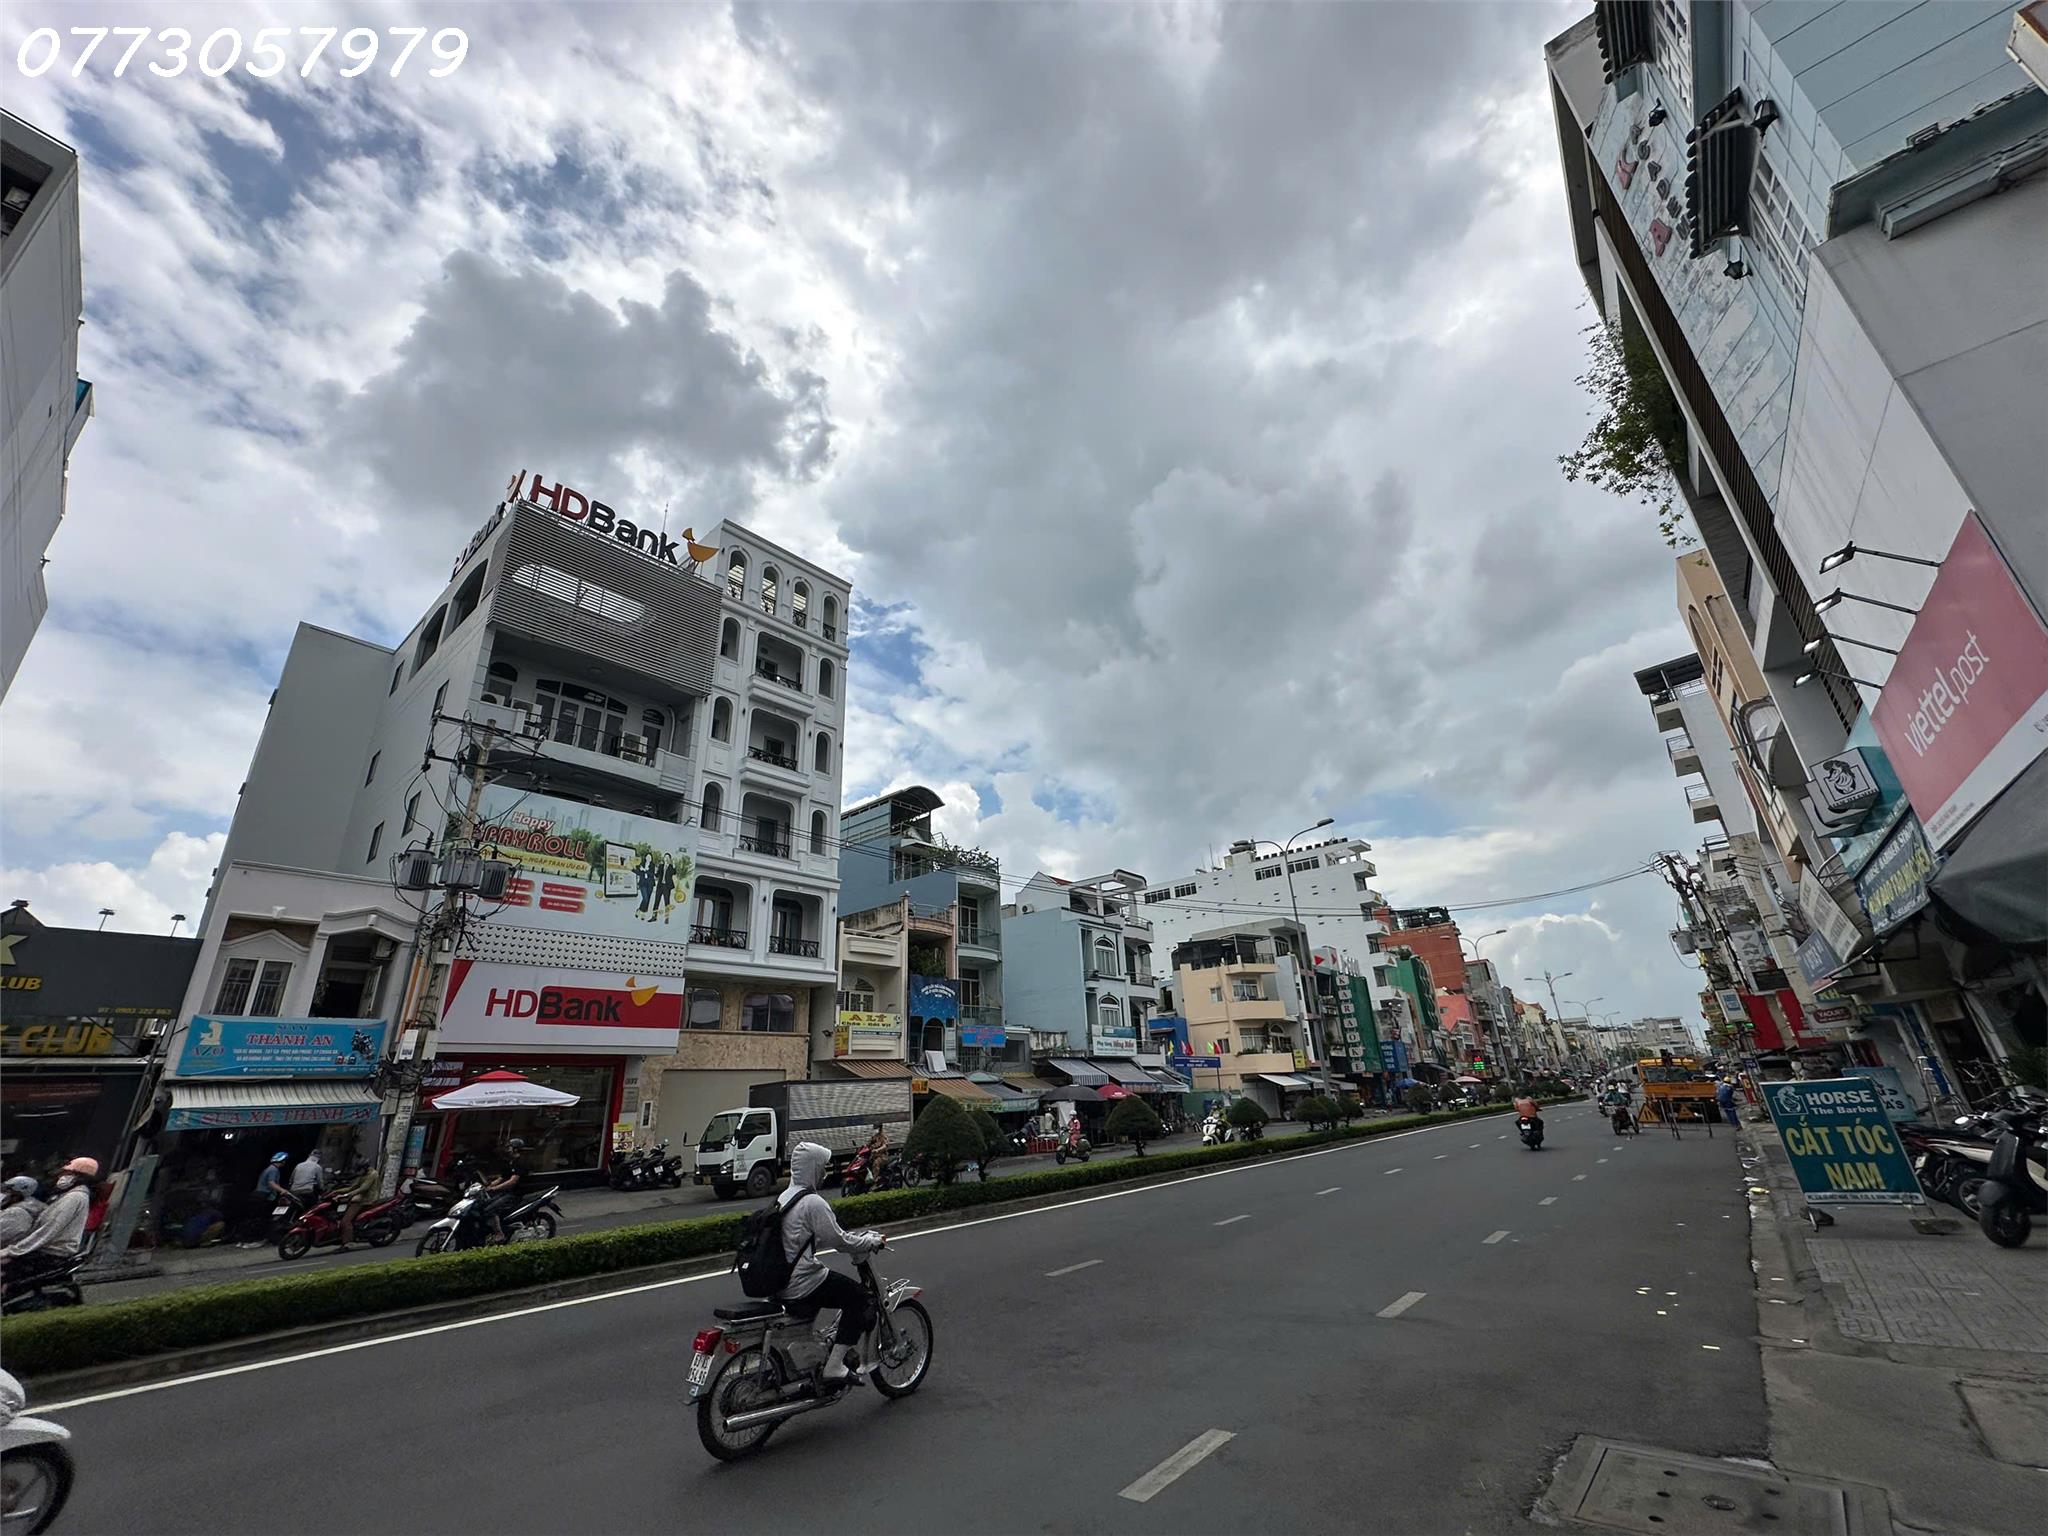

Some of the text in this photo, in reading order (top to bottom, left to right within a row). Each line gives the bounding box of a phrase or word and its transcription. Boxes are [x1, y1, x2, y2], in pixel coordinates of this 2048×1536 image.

[530, 474, 679, 565] HDBank
[511, 811, 556, 832] Happy
[482, 824, 586, 859] PAYROLL
[0, 977, 42, 990] LUB
[485, 988, 622, 1022] HDBank
[1338, 977, 1363, 1071] KARAOKE
[311, 1035, 333, 1046] AN
[1805, 1090, 1875, 1105] HORSE
[247, 1110, 273, 1123] XE
[1811, 1106, 1878, 1115] The Barber
[1785, 1115, 1895, 1156] CẮT TÓC
[1823, 1162, 1887, 1191] NAM
